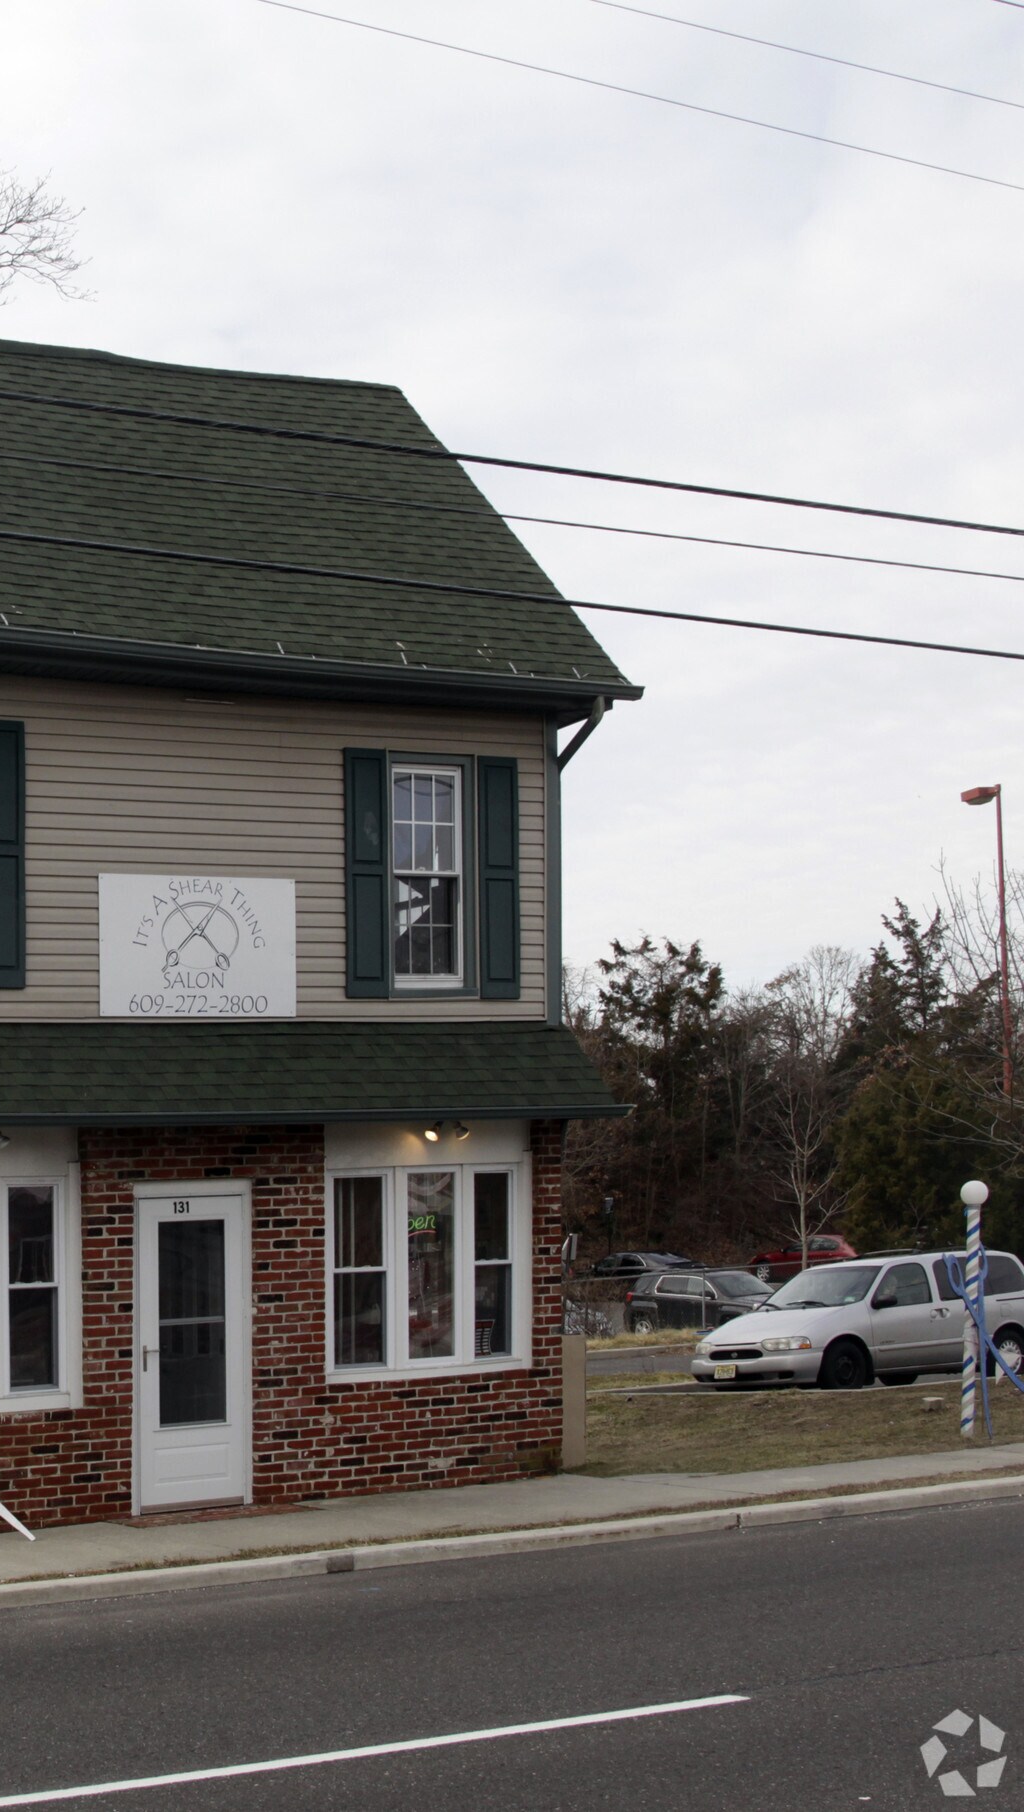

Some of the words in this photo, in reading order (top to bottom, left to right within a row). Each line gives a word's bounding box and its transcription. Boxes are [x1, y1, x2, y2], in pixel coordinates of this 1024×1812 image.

[132, 915, 154, 947] IT'S
[152, 894, 168, 916] A
[168, 878, 223, 900] SHEAR
[230, 887, 266, 949] THING
[163, 971, 225, 990] SALON
[128, 993, 269, 1015] 609-272-2800
[172, 1201, 190, 1214] 131
